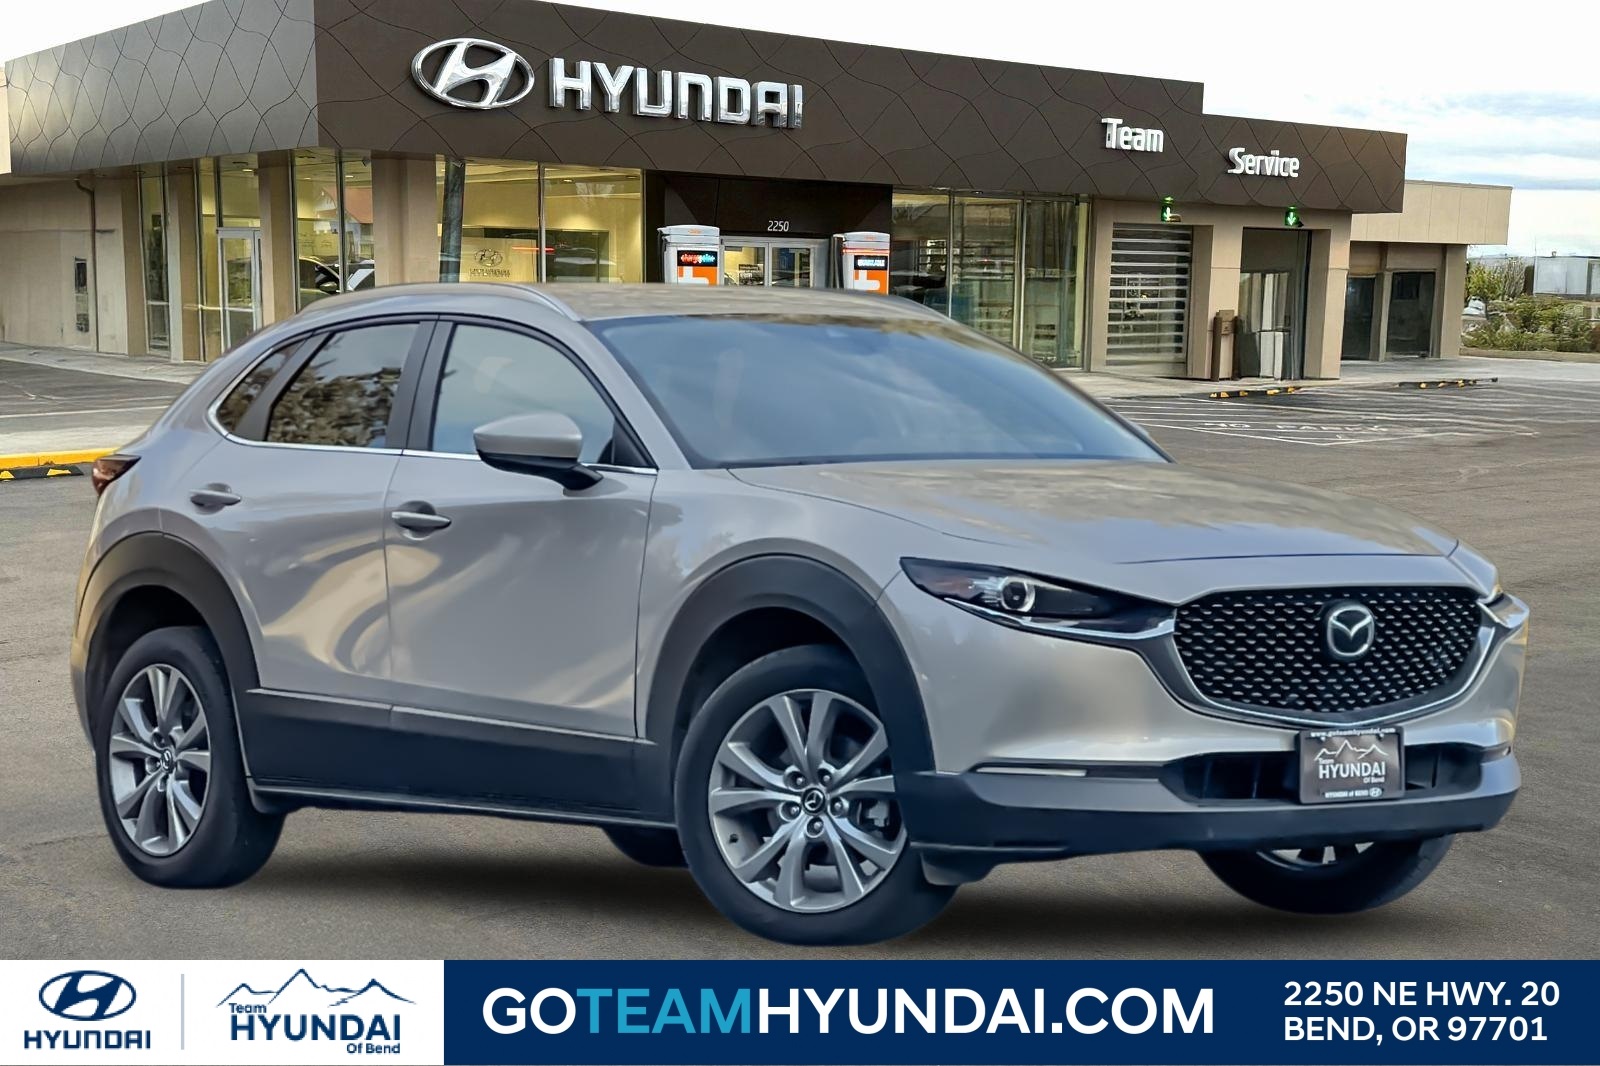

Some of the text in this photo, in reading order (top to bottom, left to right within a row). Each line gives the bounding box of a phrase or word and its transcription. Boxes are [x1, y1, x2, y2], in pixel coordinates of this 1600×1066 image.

[549, 57, 803, 129] HYUNDAI
[1102, 117, 1164, 152] Team
[1227, 147, 1300, 177] Service
[767, 220, 790, 232] 2250
[1318, 761, 1386, 779] HYUNDAI
